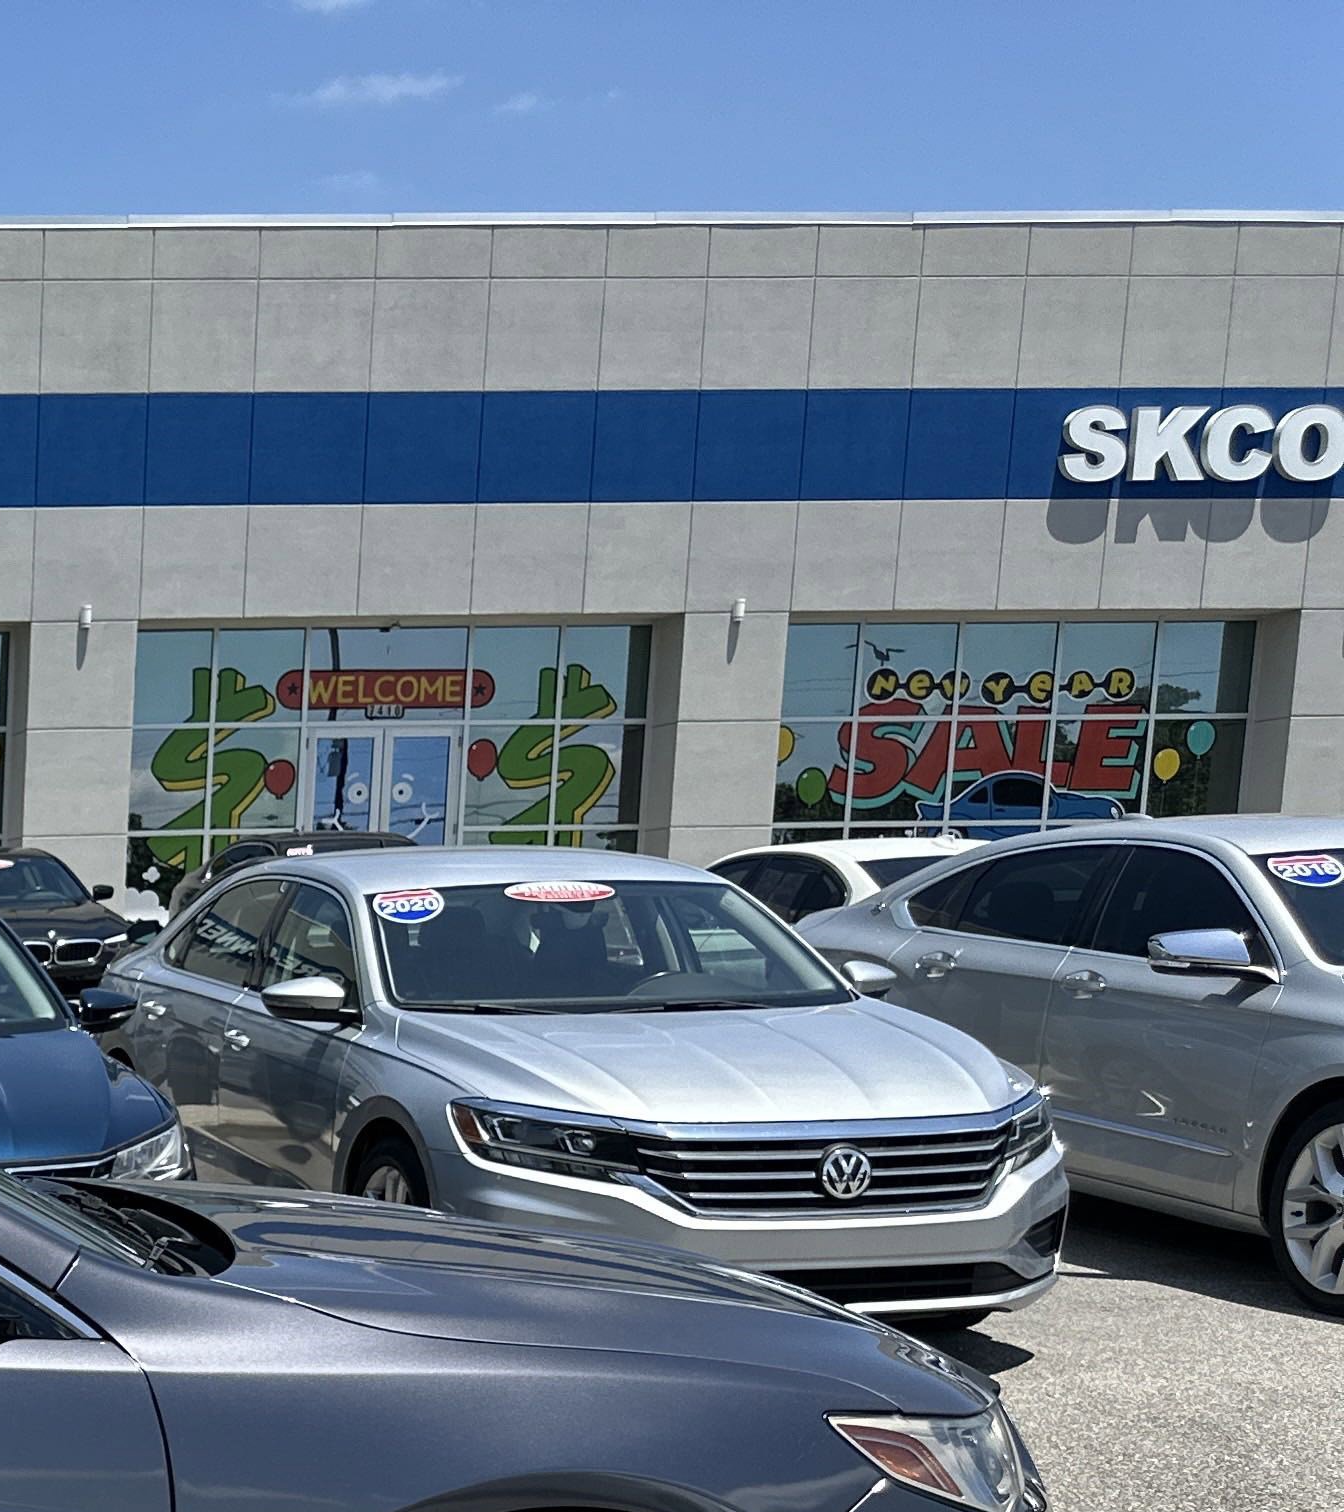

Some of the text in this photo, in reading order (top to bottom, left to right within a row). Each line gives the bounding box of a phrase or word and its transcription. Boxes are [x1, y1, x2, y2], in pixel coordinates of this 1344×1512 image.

[1057, 404, 1344, 482] SKCO
[310, 675, 463, 704] WELCOME
[827, 699, 1149, 809] SALE
[1277, 863, 1341, 878] 2018
[380, 896, 439, 915] 2020
